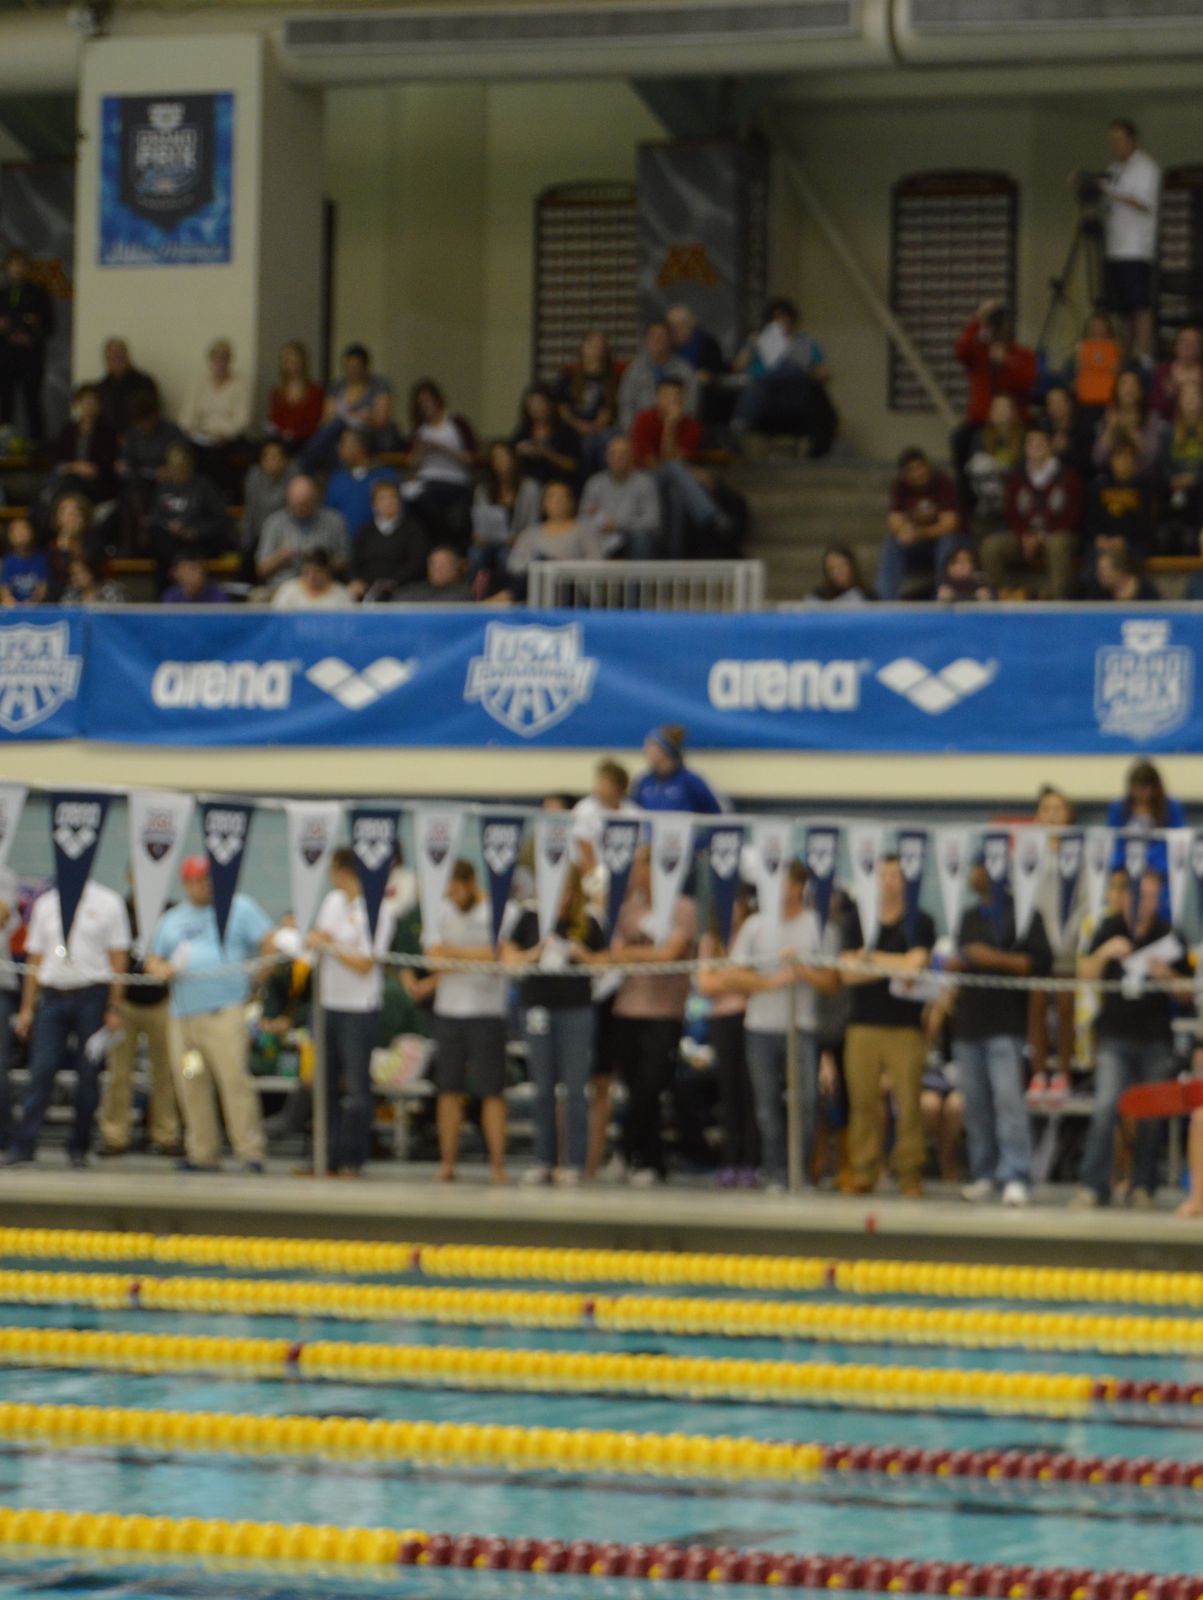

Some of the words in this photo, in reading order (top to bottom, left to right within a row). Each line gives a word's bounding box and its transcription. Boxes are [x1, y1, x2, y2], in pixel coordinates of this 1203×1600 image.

[496, 637, 563, 663] USA
[152, 659, 292, 709] arena
[707, 658, 860, 713] arena
